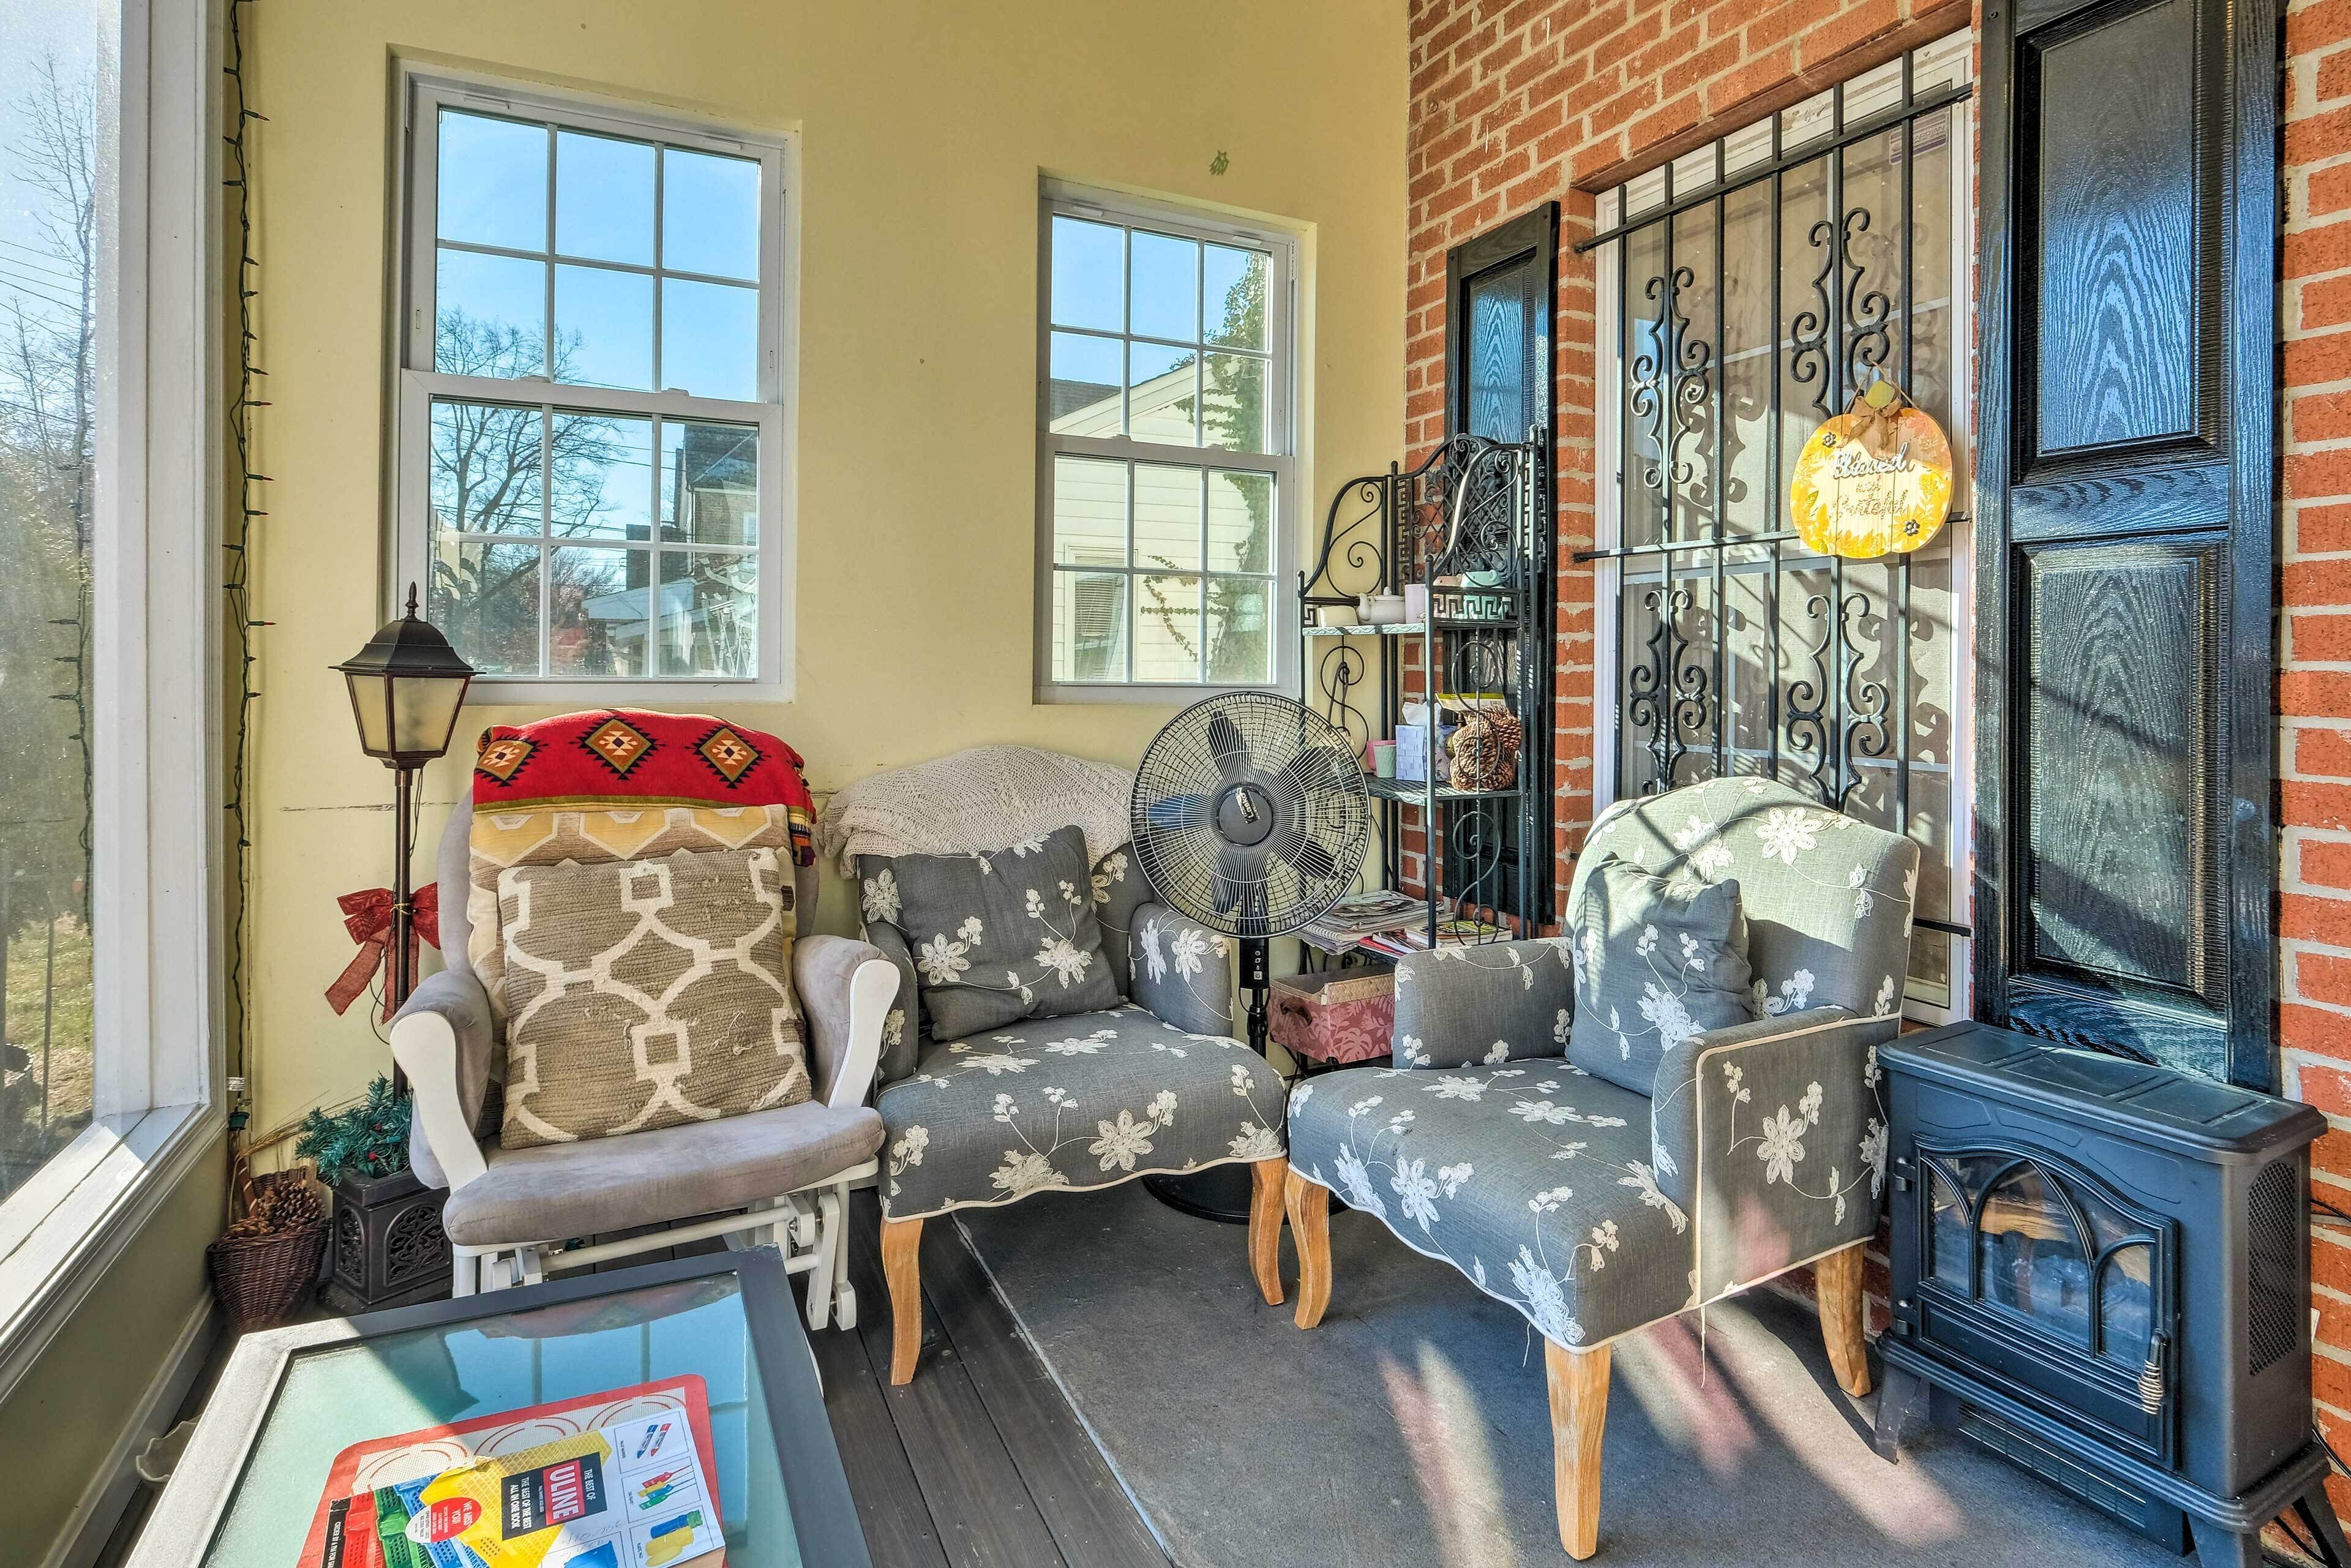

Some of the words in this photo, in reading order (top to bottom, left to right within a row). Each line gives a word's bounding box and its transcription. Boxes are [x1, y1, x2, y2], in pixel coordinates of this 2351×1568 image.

[1241, 792, 1254, 818] Lasko
[583, 1468, 593, 1480] THE
[510, 1483, 519, 1494] ALL
[585, 1479, 594, 1492] BEST
[521, 1487, 530, 1499] BEST
[549, 1465, 579, 1520] ULINE
[587, 1491, 595, 1501] OF
[463, 1501, 472, 1511] WE
[511, 1500, 519, 1513] ONE
[522, 1499, 530, 1508] OF
[451, 1509, 461, 1524] YOU!
[463, 1512, 472, 1525] MISS
[511, 1512, 520, 1529] BOOK
[522, 1516, 531, 1529] BEST
